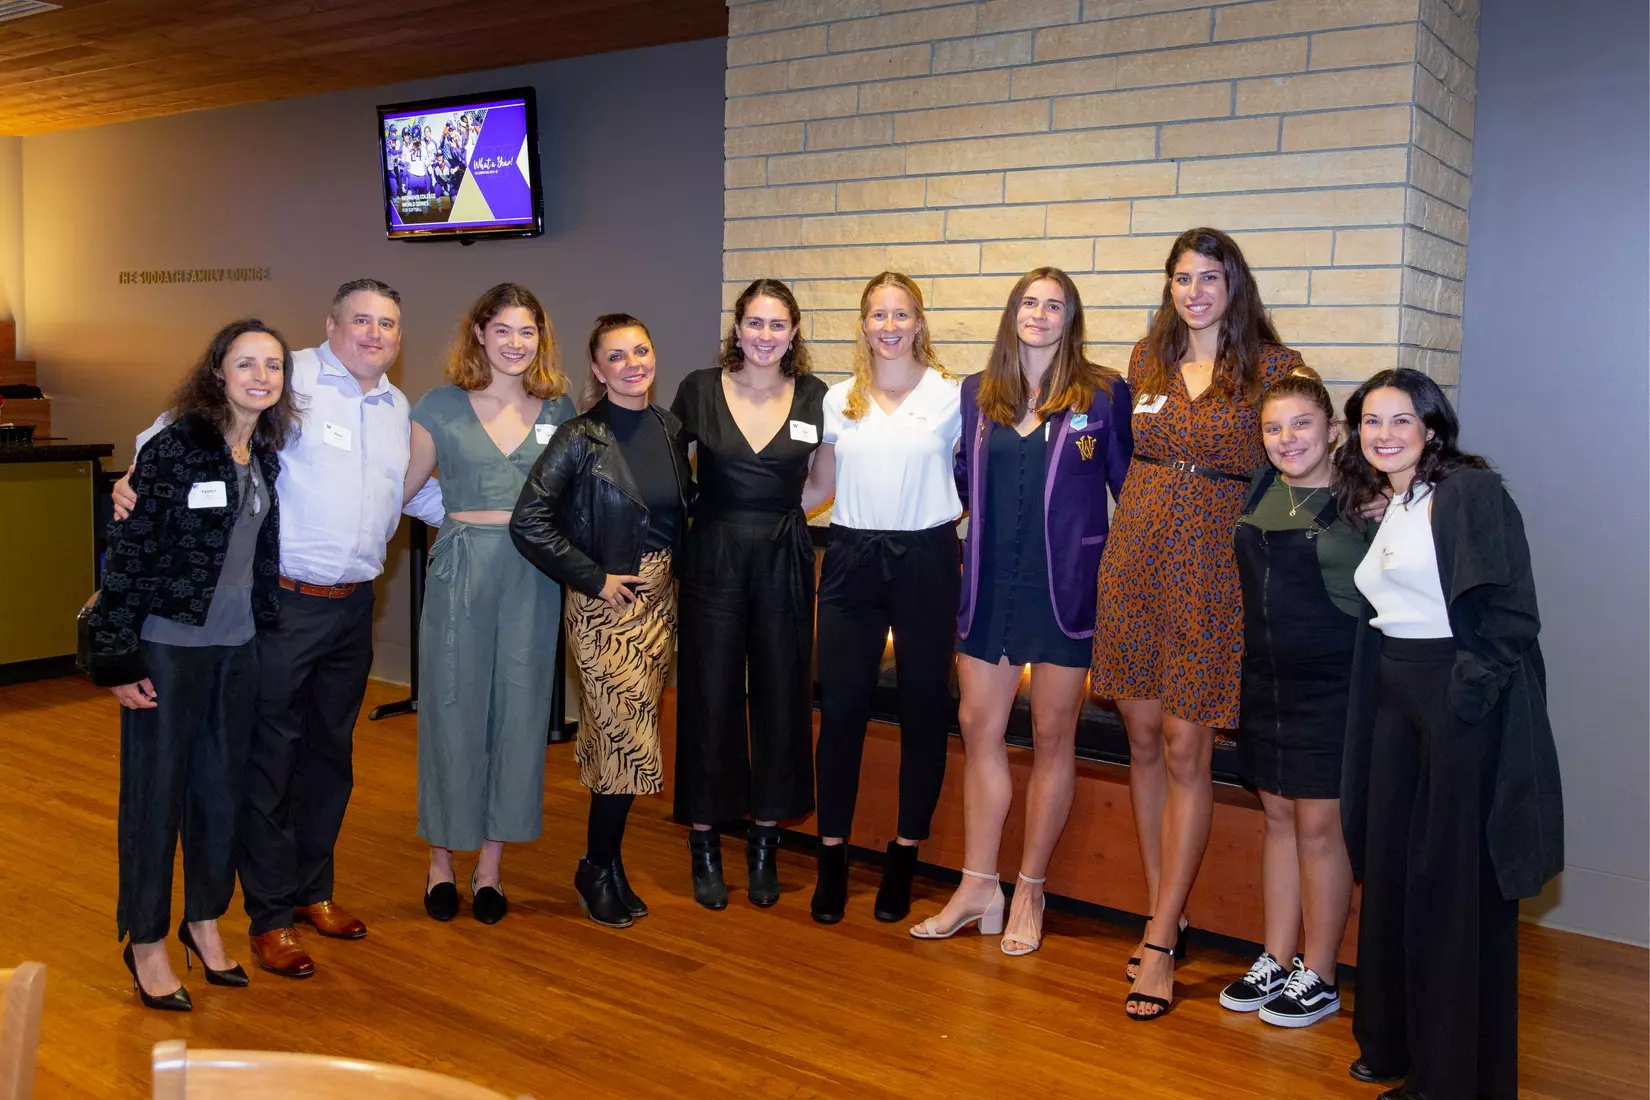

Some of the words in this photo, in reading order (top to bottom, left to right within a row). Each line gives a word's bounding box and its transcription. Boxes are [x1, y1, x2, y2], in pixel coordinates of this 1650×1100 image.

[473, 157, 491, 170] What
[497, 156, 513, 168] Year!
[119, 270, 137, 284] THE
[138, 269, 184, 284] SUDDATH
[186, 268, 225, 283] FAMILY
[227, 267, 272, 282] LOUNGE
